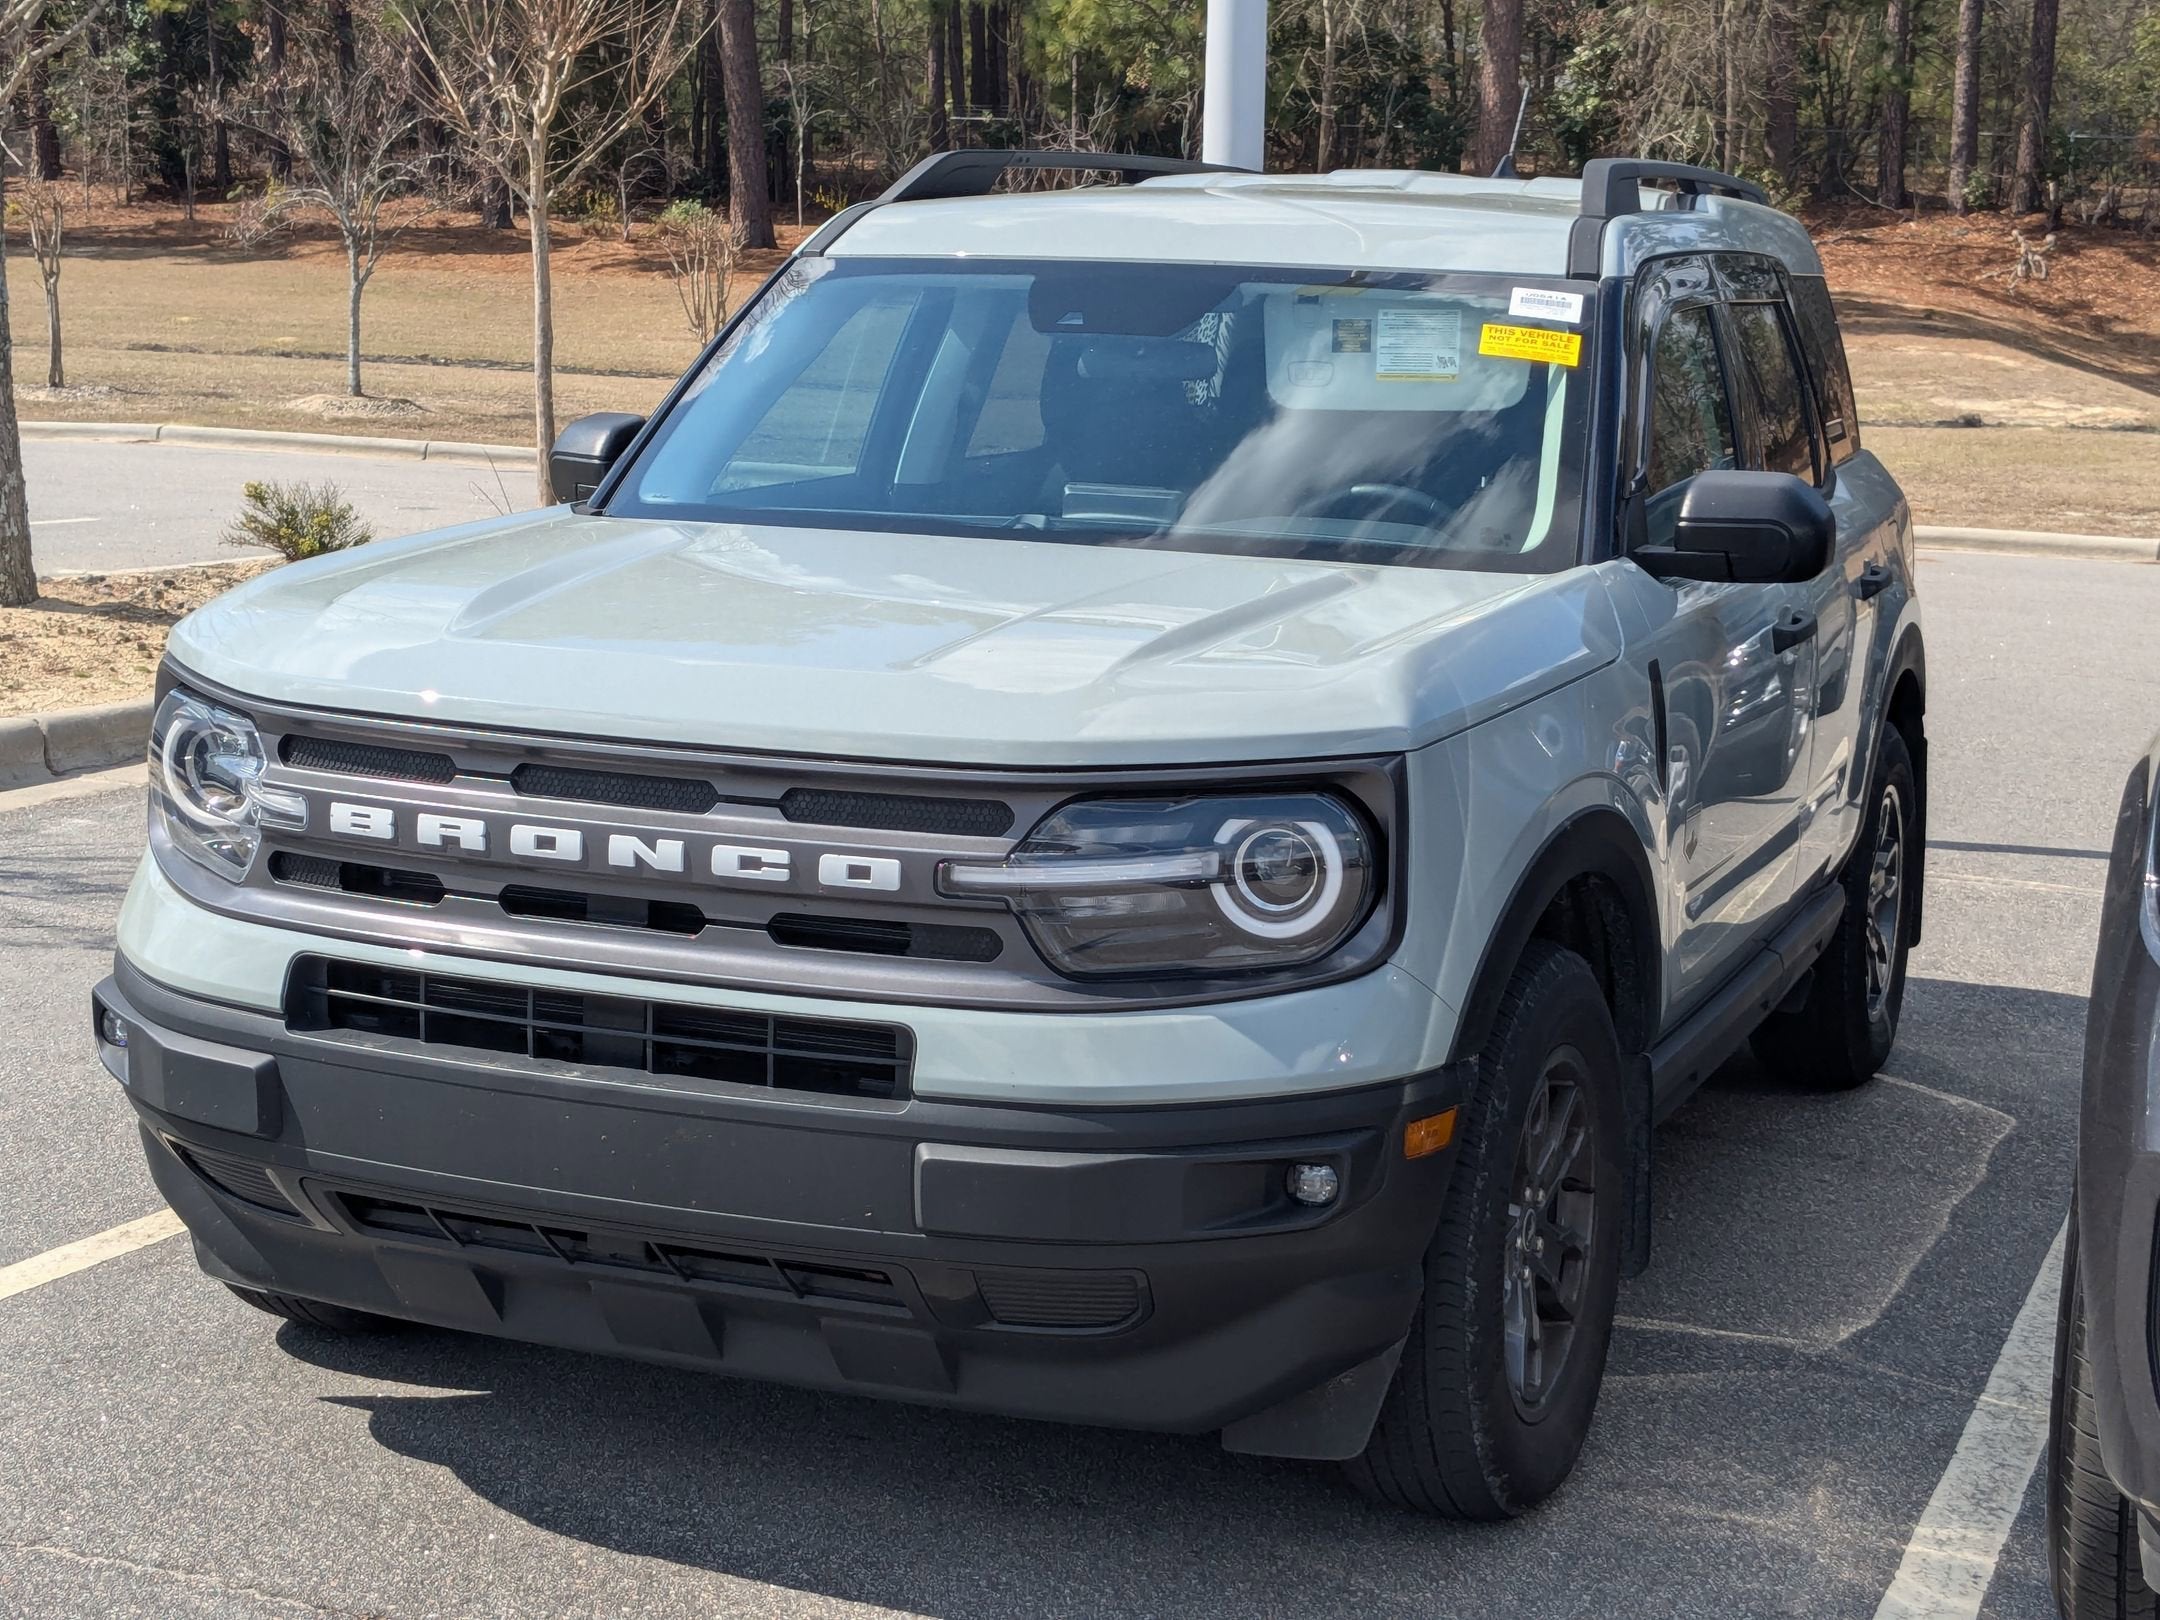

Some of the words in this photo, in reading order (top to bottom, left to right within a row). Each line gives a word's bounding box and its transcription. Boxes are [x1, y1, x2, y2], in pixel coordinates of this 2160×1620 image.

[1487, 327, 1516, 336] THIS
[1520, 331, 1574, 344] VEHICLE
[1542, 341, 1570, 350] SALE
[330, 801, 902, 892] BRONCO
